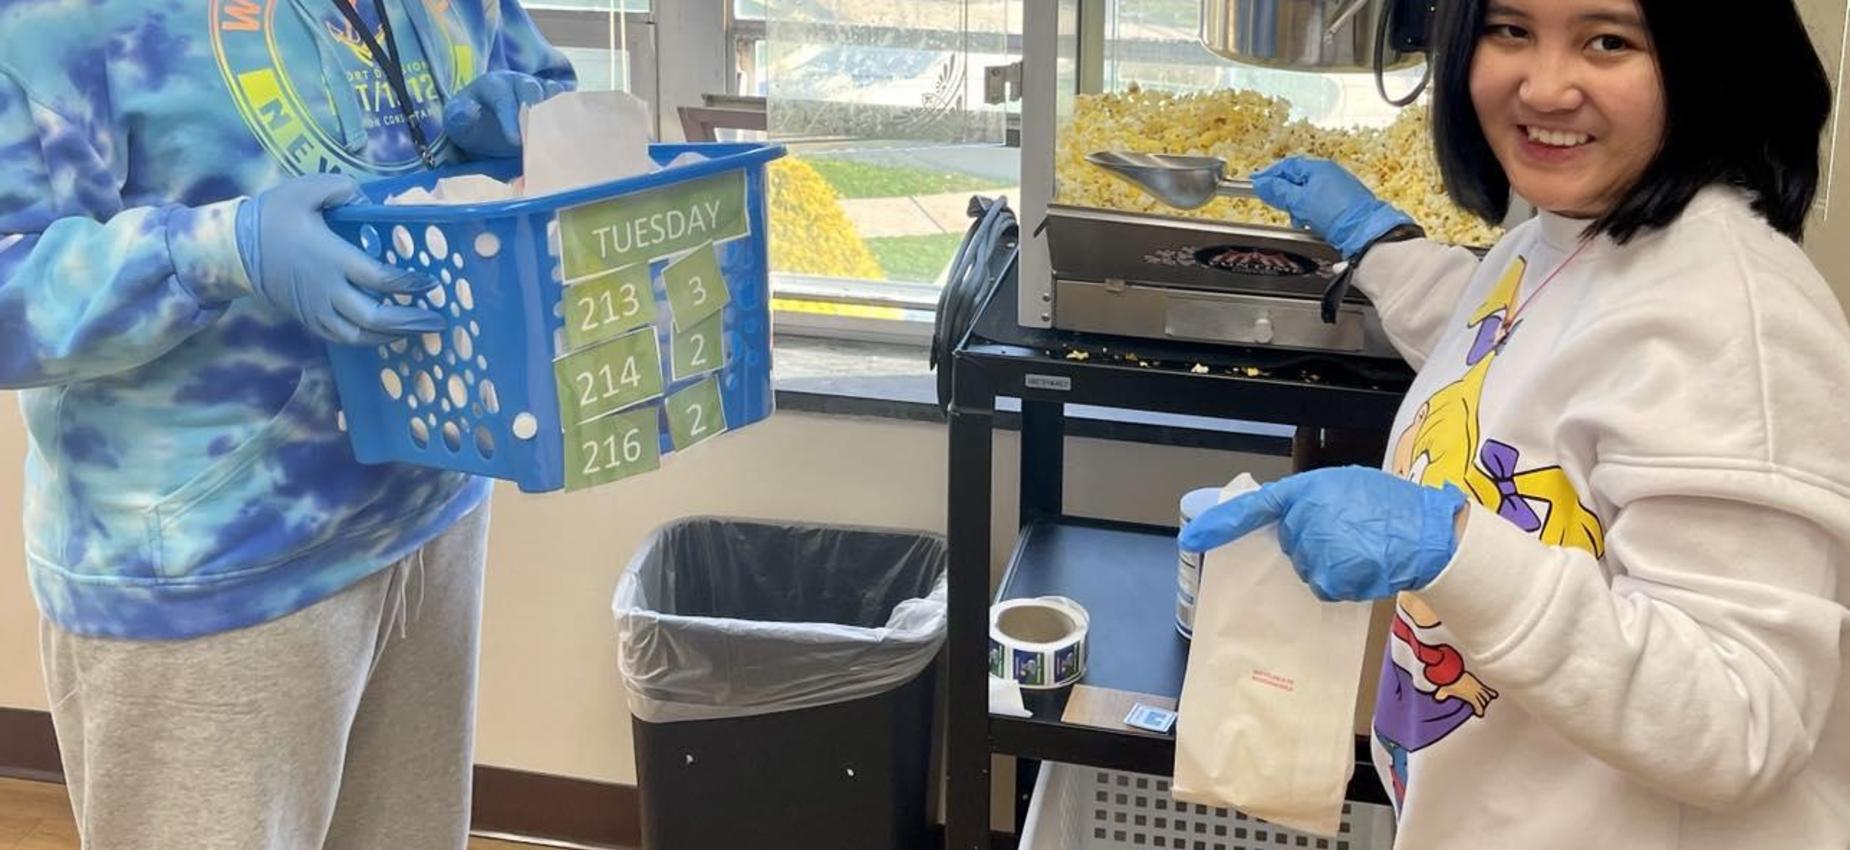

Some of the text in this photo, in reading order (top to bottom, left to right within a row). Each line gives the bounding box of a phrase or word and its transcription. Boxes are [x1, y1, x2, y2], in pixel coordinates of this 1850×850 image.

[592, 200, 722, 259] TUESDAY
[577, 283, 641, 332] 213
[688, 275, 708, 306] 3
[689, 333, 708, 367] 2
[576, 355, 641, 407] 214
[687, 403, 708, 436] 2
[582, 427, 642, 475] 216
